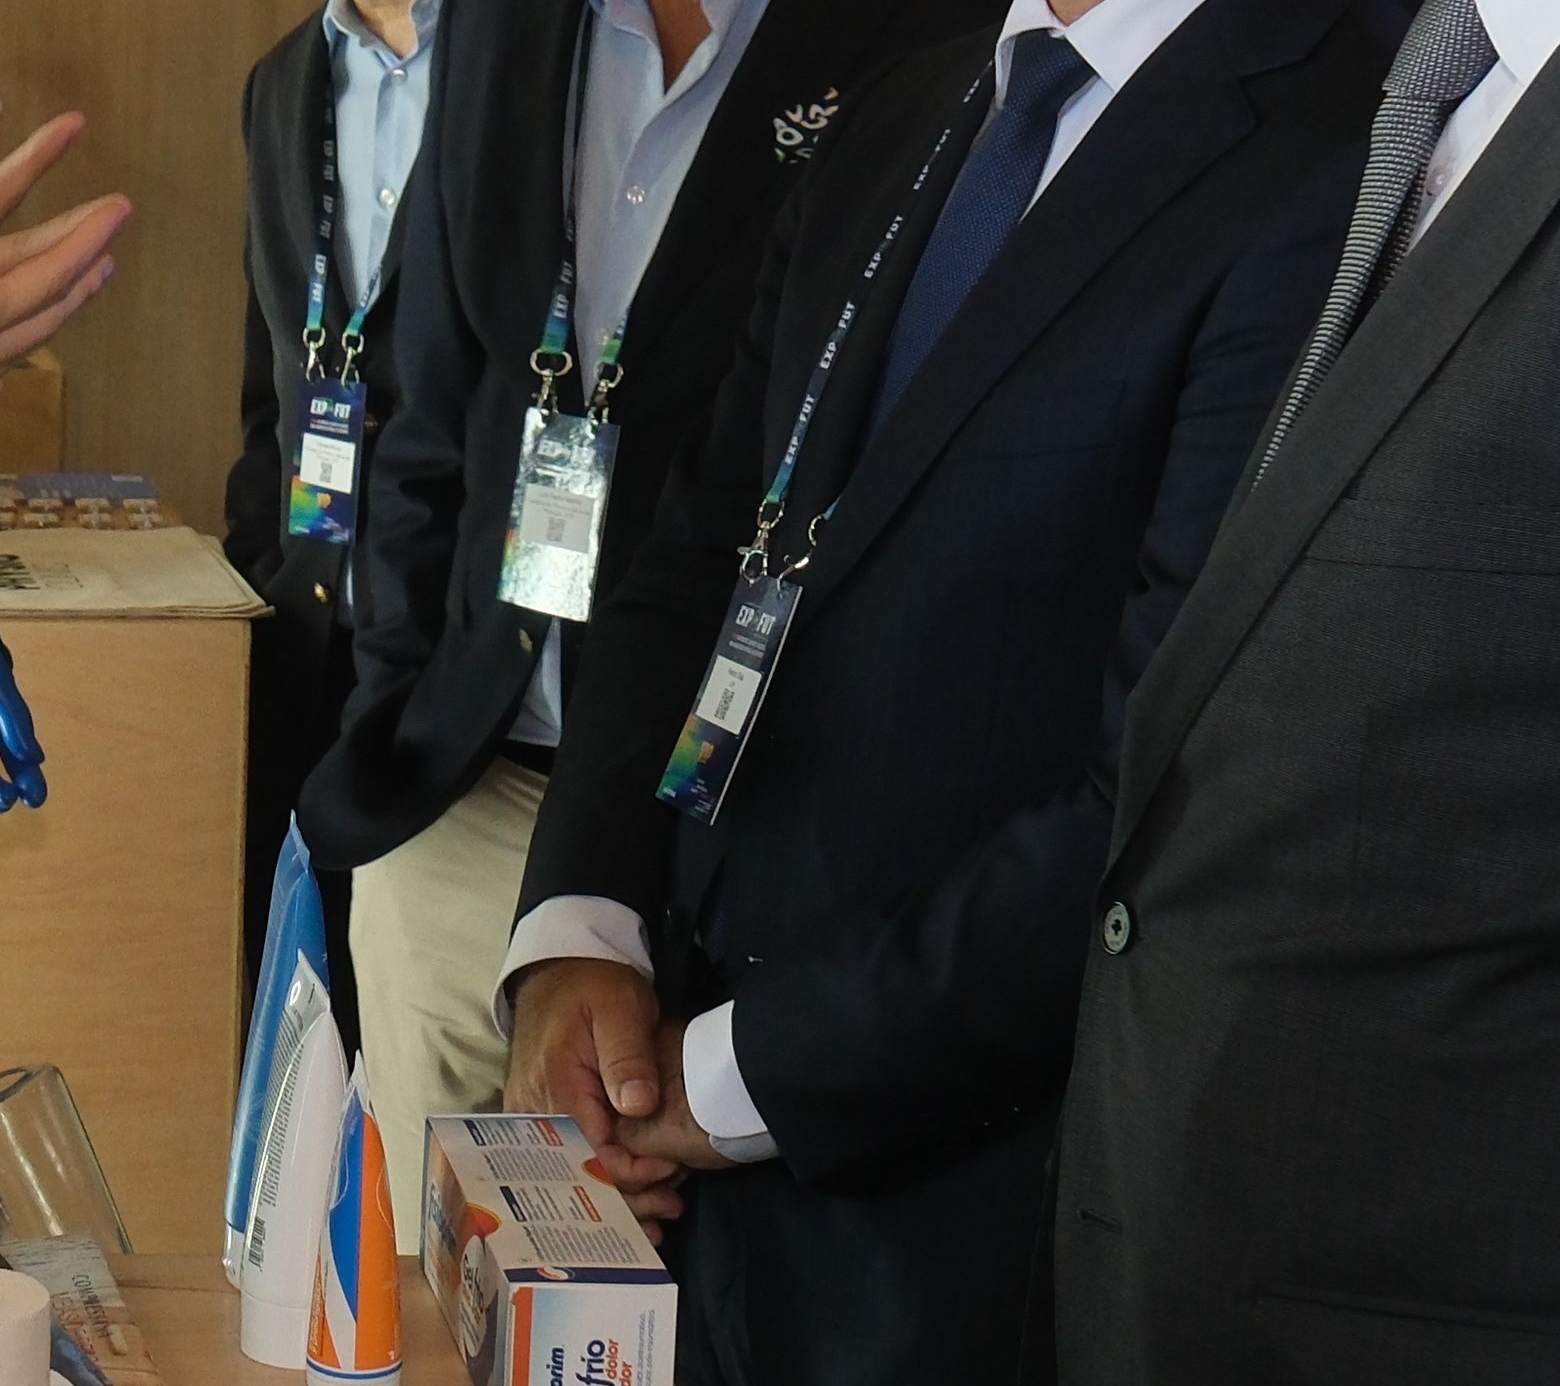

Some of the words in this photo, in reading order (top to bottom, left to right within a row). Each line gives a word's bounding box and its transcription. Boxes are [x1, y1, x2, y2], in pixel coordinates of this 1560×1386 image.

[864, 251, 882, 279] EXP
[885, 215, 903, 240] FUT
[820, 341, 837, 370] EXP
[837, 301, 857, 330] FUT
[785, 435, 800, 465] EXP
[799, 394, 815, 424] FUT
[605, 1338, 619, 1379] dolor
